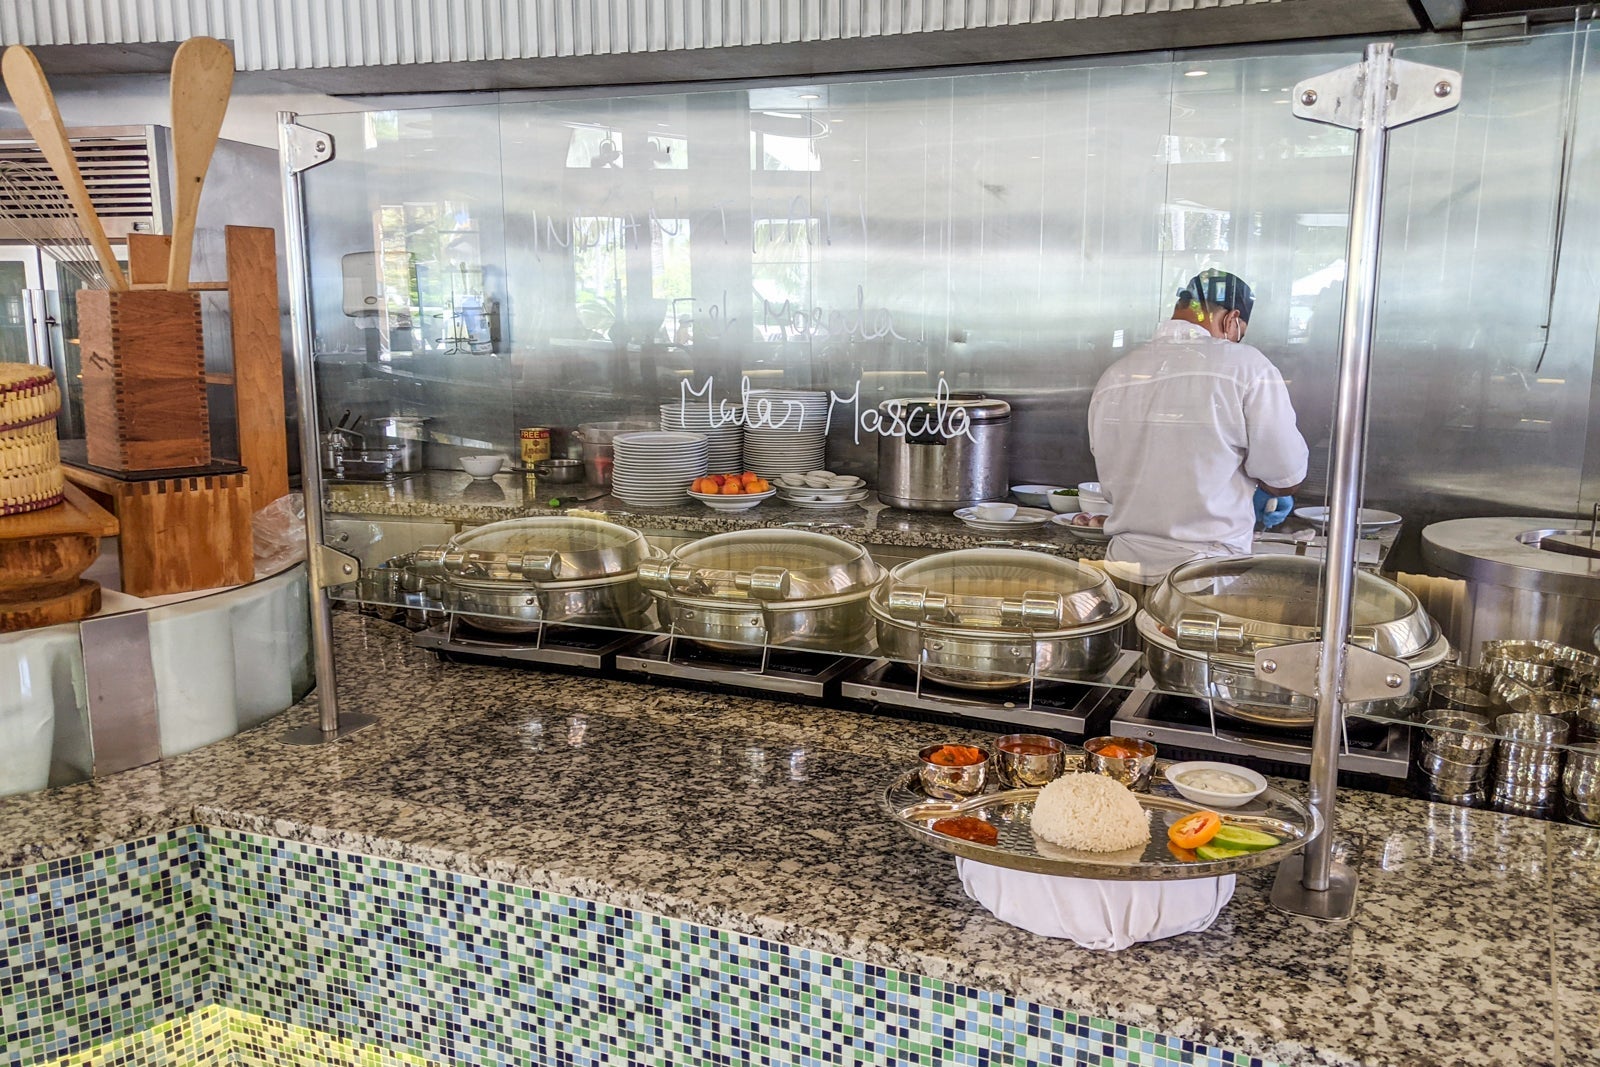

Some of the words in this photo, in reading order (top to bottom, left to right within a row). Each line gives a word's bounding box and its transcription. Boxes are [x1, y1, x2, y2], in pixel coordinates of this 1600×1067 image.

[671, 288, 738, 342] Fsh
[521, 430, 540, 439] FREE
[824, 377, 979, 445] Masala
